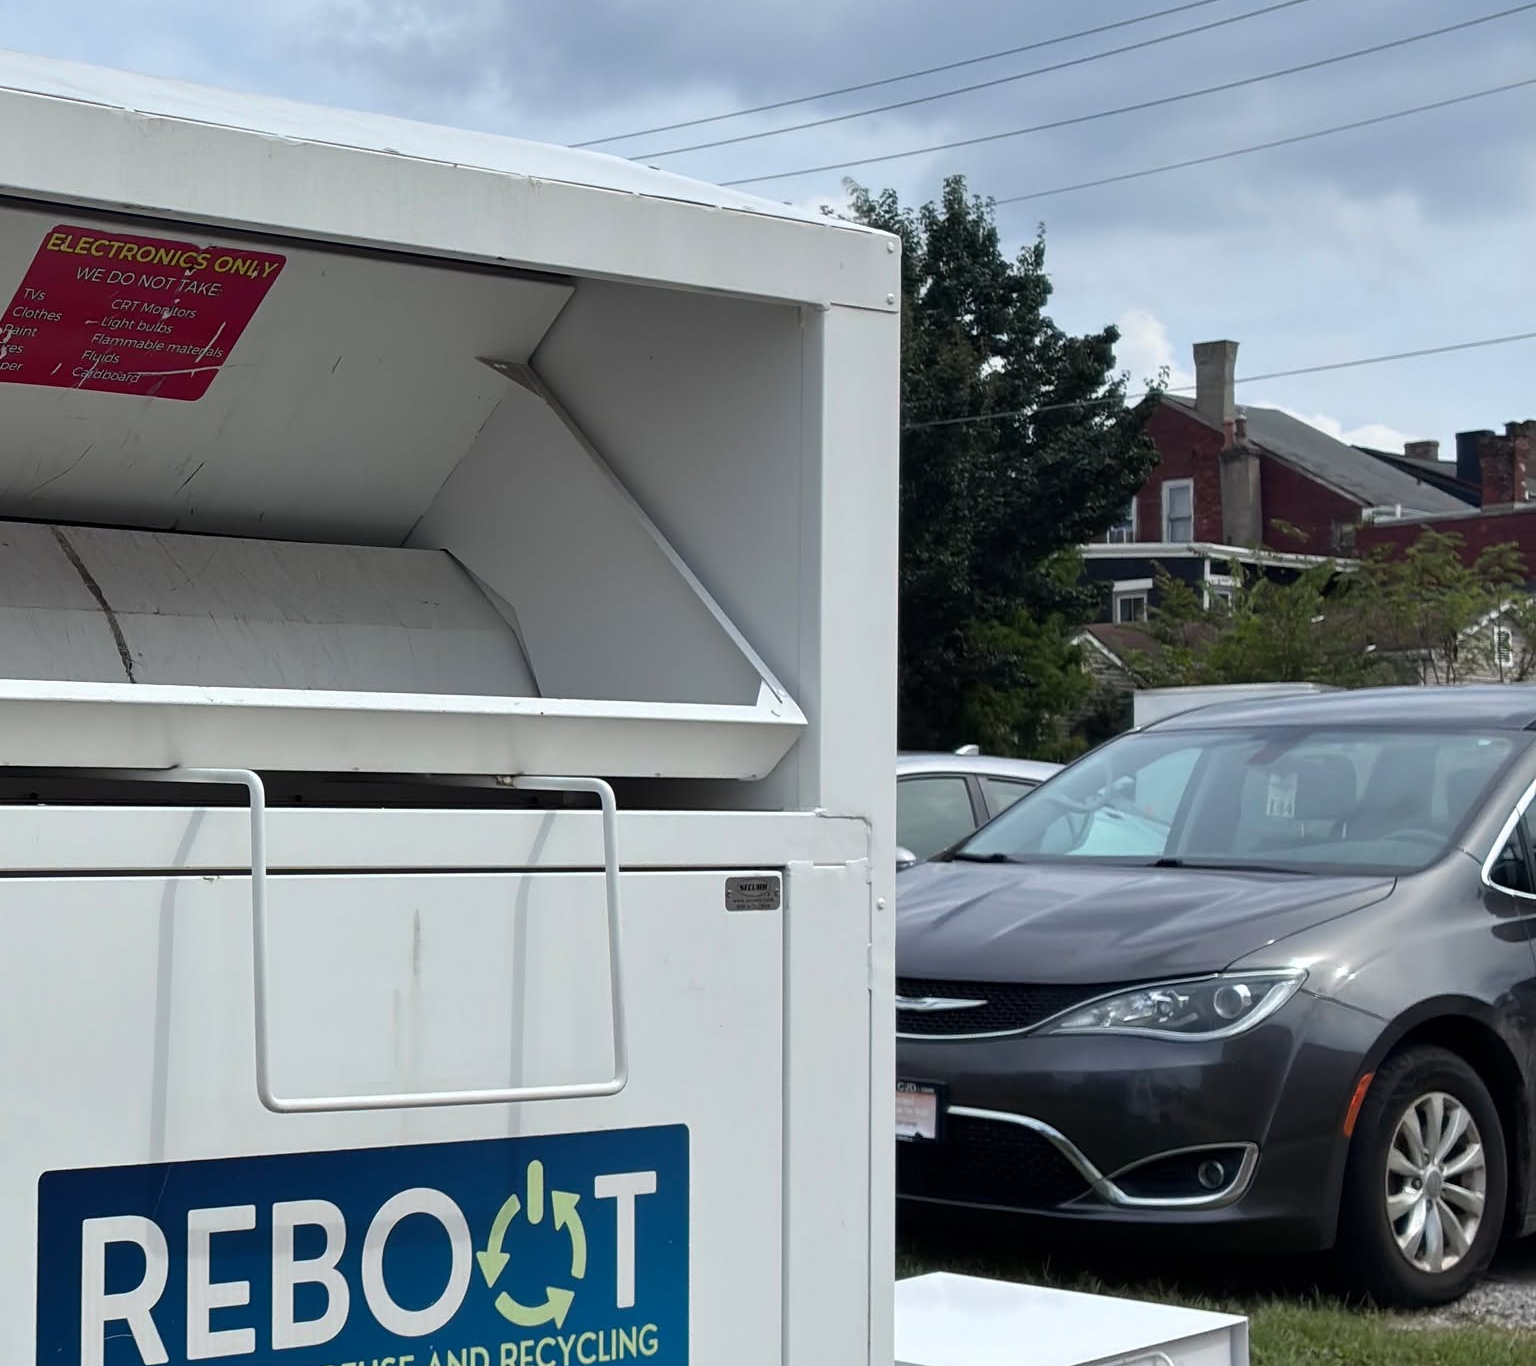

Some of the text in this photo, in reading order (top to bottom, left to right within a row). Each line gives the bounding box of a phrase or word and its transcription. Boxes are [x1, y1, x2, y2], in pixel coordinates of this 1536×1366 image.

[47, 233, 279, 279] ELECTRONICS ONLY
[76, 267, 222, 297] WE DO NOT TAKE:
[22, 288, 46, 302] TVs
[12, 306, 63, 322] Clothes
[111, 299, 197, 319] CRT Monitors
[2, 323, 38, 338] Paint
[100, 316, 173, 334] Light bulbs
[91, 333, 224, 358] Flammable materals
[81, 350, 121, 364] Fluids
[72, 367, 141, 384] Cardboard
